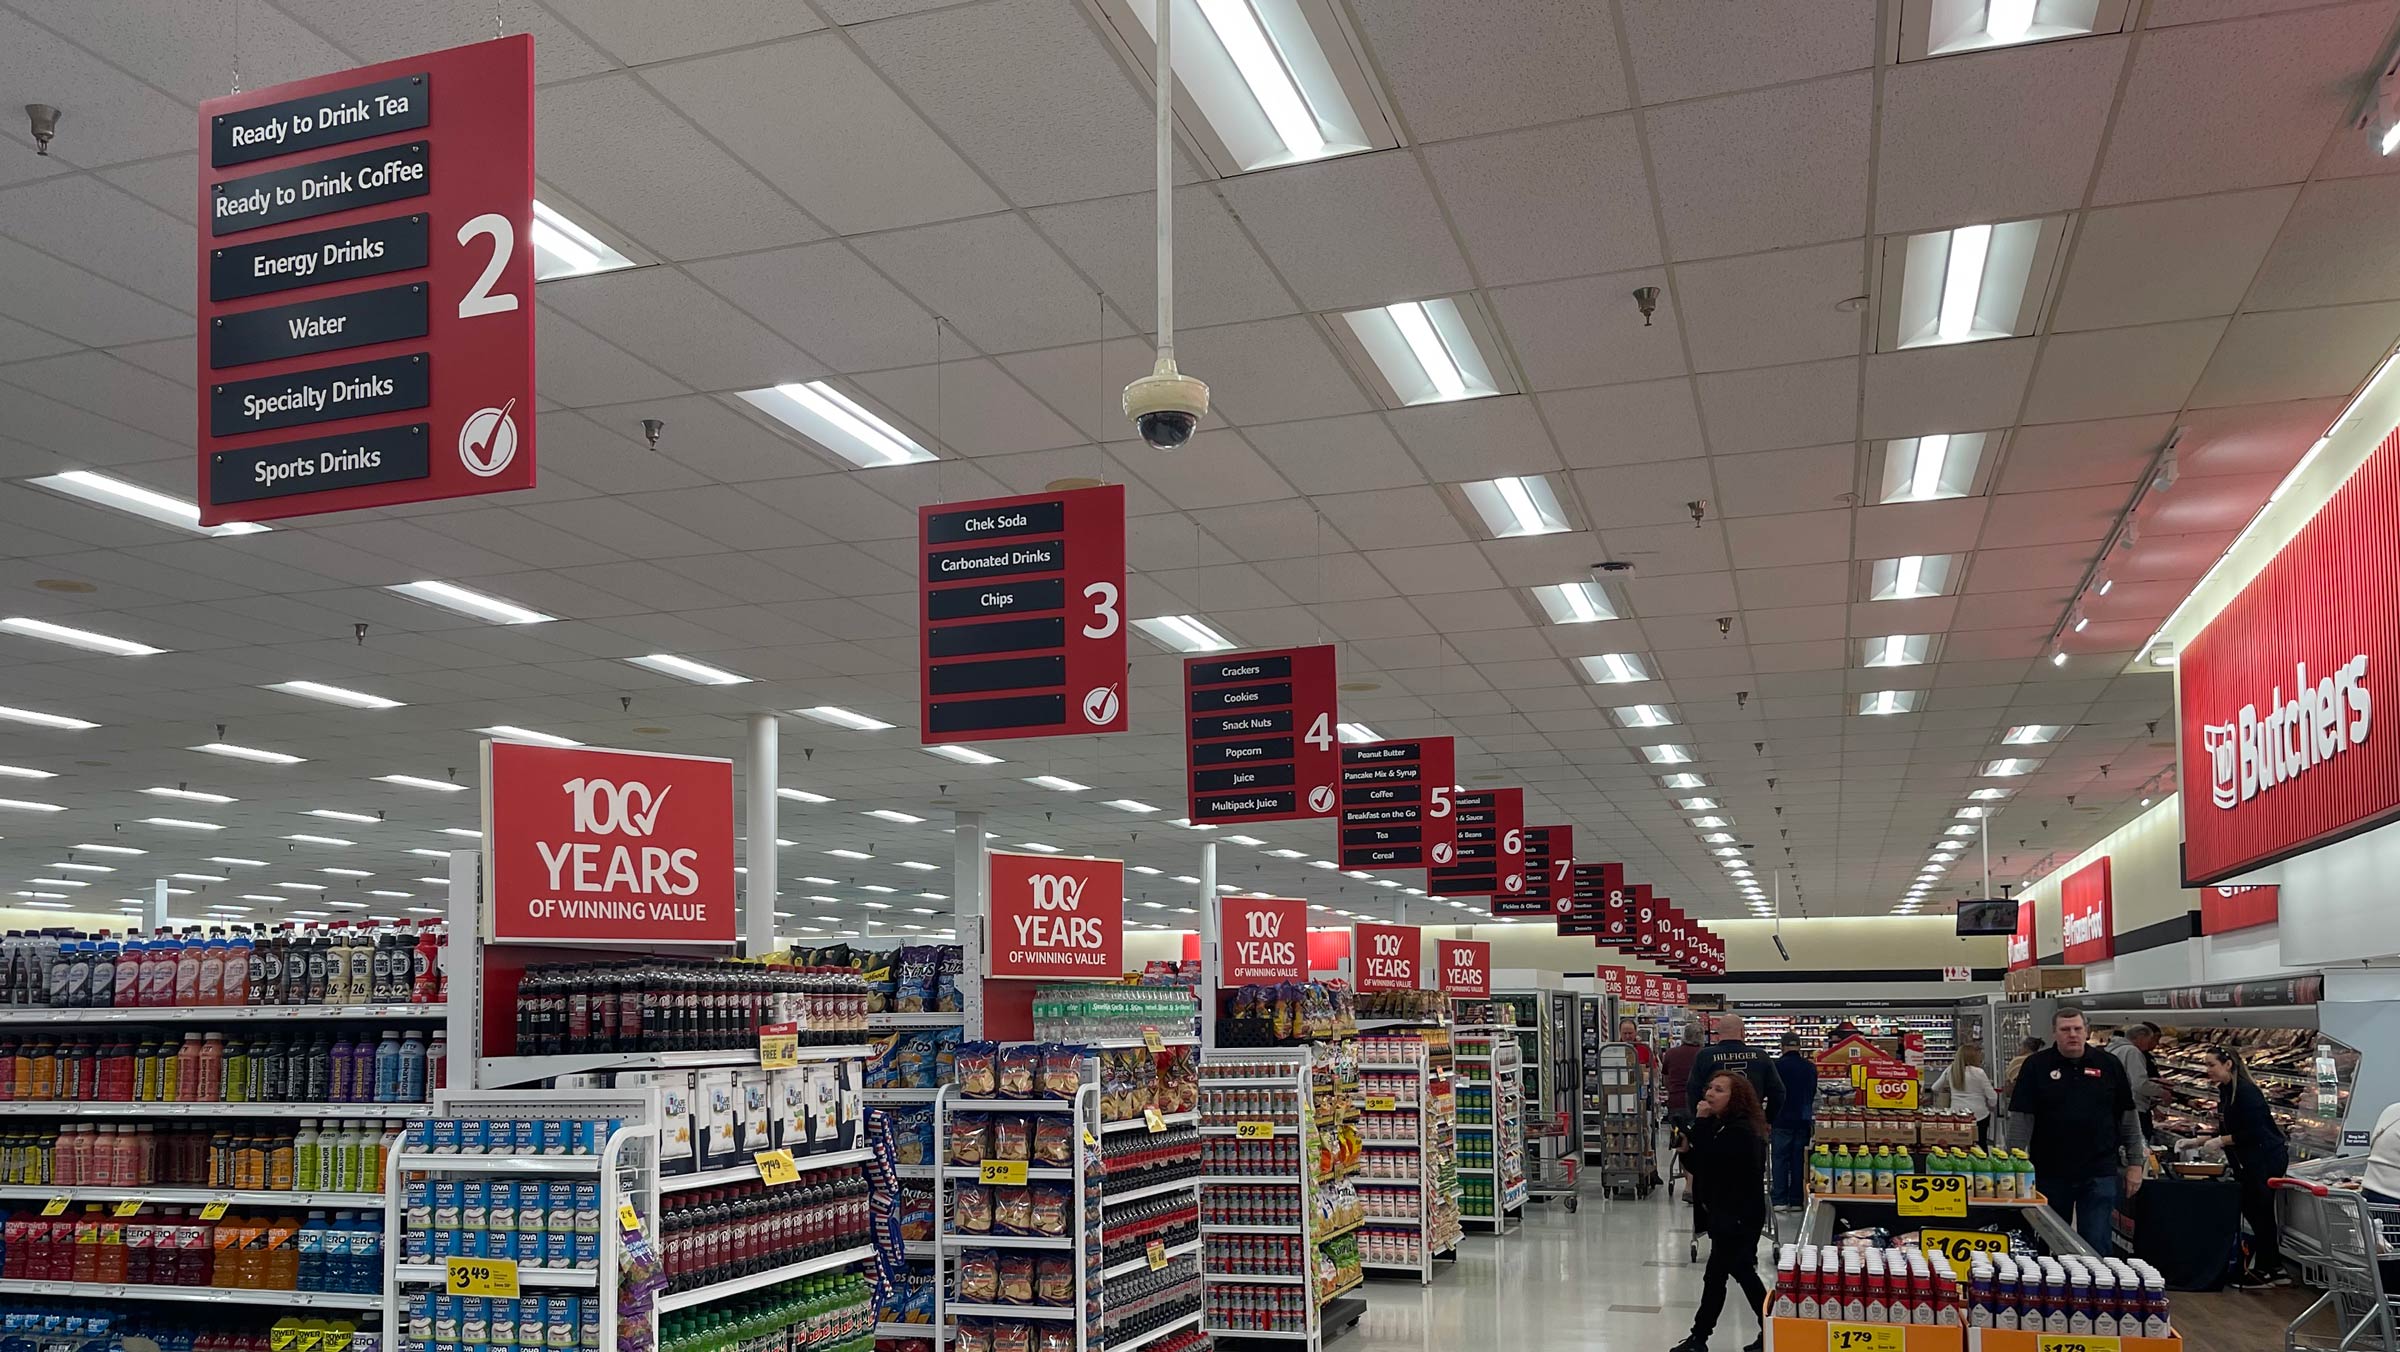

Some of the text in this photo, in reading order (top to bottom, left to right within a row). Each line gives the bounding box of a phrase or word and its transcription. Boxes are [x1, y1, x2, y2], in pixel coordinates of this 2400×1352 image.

[232, 94, 409, 147] Ready to Drink Tea
[216, 160, 424, 218] Ready to Drink Coffee
[253, 238, 384, 278] Energy Drinks
[457, 213, 519, 319] 2
[289, 315, 347, 340] Water
[243, 376, 394, 417] Specialty Drinks
[254, 449, 381, 485] Sports Drinks
[965, 514, 1028, 533] Chek Soda
[941, 549, 1051, 573] Carbonated Drinks
[980, 592, 1014, 607] Chips
[1082, 582, 1120, 639] 3
[1222, 665, 1260, 677] Crackers
[1223, 691, 1259, 703] Cookies
[1222, 717, 1272, 730] Snack Nuts
[2239, 654, 2372, 802] Butchers
[1304, 712, 1333, 751] 4
[1225, 746, 1262, 759] Popcorn
[1233, 771, 1255, 783] Juice
[1345, 771, 1373, 780] Pancake
[1374, 770, 1387, 778] Mix
[1396, 769, 1417, 778] Syrup
[562, 778, 653, 837] 100
[1212, 797, 1278, 812] Multipack Juice
[1430, 787, 1451, 818] 5
[1347, 812, 1380, 820] Breakfast
[1392, 810, 1404, 818] the
[1503, 829, 1522, 854] 6
[1372, 851, 1394, 859] Cereal
[536, 841, 699, 896] YEARS
[1554, 860, 1570, 881] 7
[1027, 874, 1078, 911] 100
[1610, 890, 1623, 908] 8
[529, 899, 707, 921] OF WINNING VALUE
[1640, 908, 1652, 923] 9
[1013, 915, 1104, 949] YEARS
[1245, 911, 1278, 938] 100
[1657, 919, 1671, 933] 10
[1672, 928, 1685, 940] 11
[1374, 934, 1399, 956] 100
[1687, 936, 1698, 948] 12
[1698, 943, 1708, 954] 13
[1009, 951, 1107, 965] OF WINNING VALUE
[1236, 941, 1295, 965] YEARS
[1453, 949, 1473, 967] 100
[1708, 948, 1717, 958] 14
[1717, 953, 1725, 962] 15
[353, 959, 367, 967] CORE
[1366, 958, 1411, 978] YEARS
[1234, 968, 1298, 978] OF WINNING VALUE
[1447, 968, 1482, 985] YEARS
[1605, 970, 1617, 981] 100
[1625, 975, 1637, 985] 100
[327, 984, 338, 994] 26
[353, 984, 365, 994] 26
[1364, 978, 1412, 988] OF WINNING VALUE
[1713, 1052, 1758, 1062] HILFIGER
[1875, 1083, 1909, 1094] BOGO
[127, 1230, 151, 1238] ZERO
[325, 1332, 351, 1340] POWER
